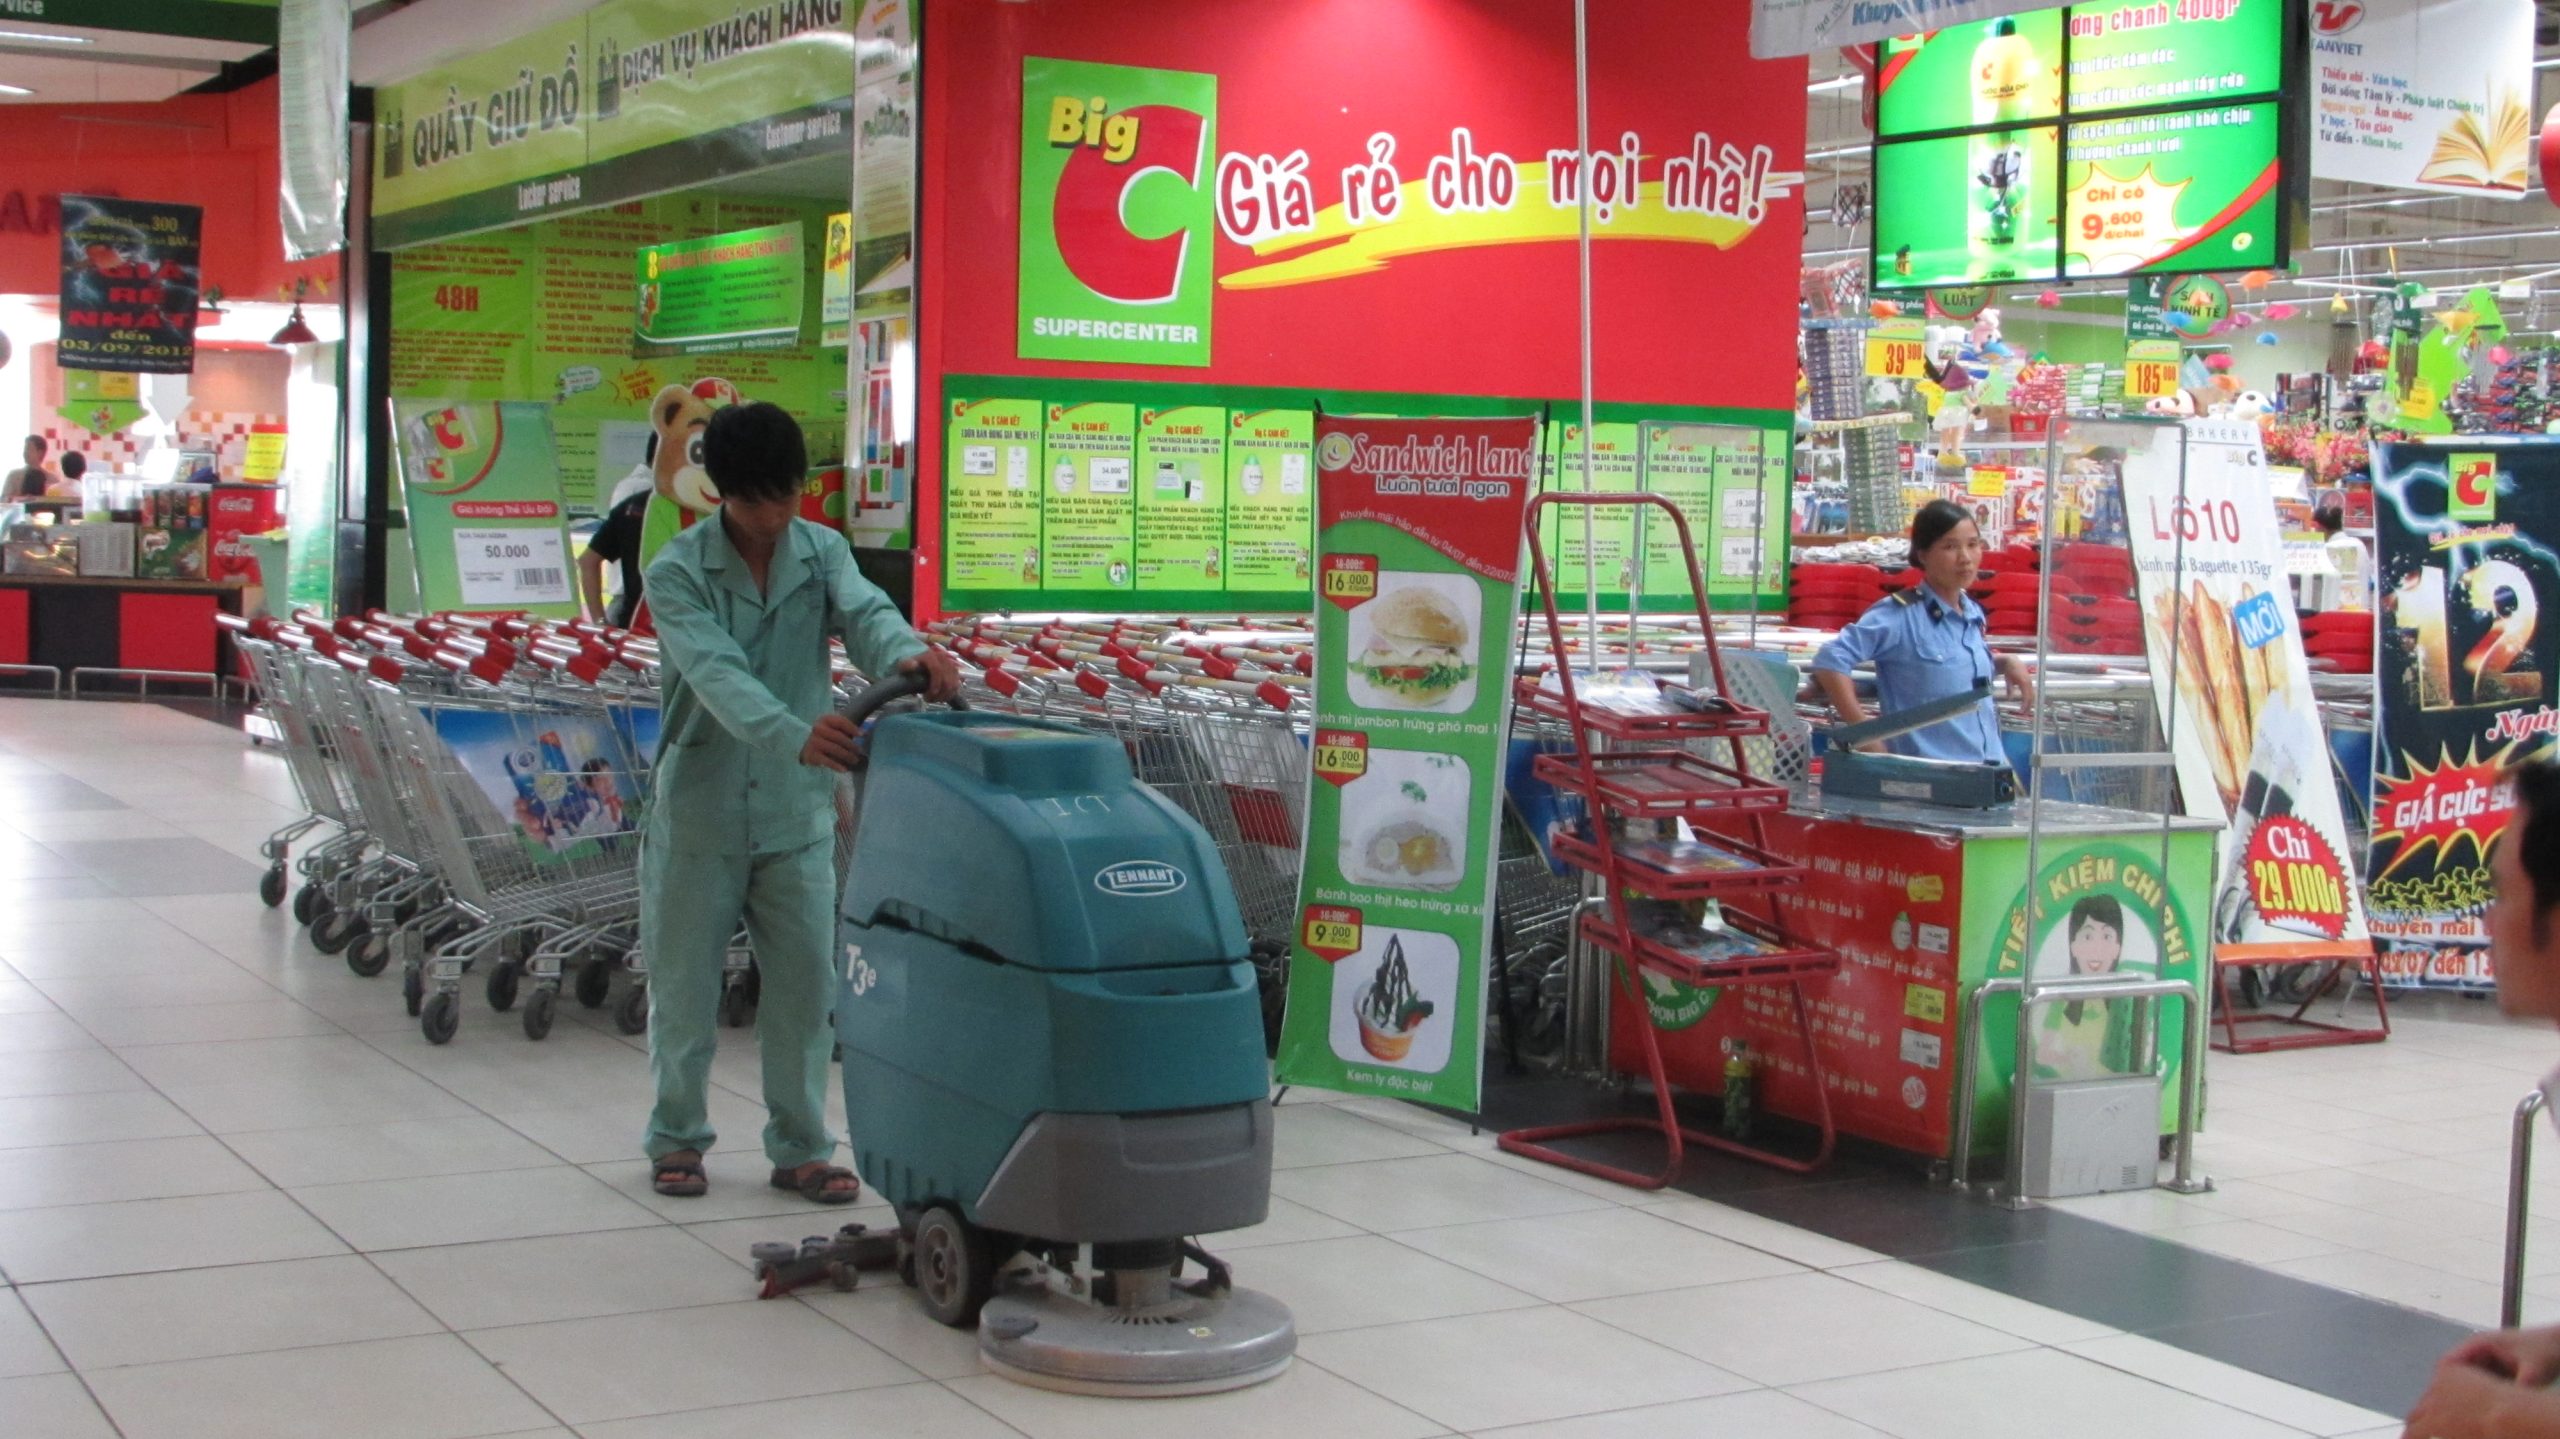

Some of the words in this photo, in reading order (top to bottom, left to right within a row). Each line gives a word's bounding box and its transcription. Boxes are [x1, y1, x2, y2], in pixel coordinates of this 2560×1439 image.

[2110, 3, 2168, 31] chanh
[623, 42, 664, 95] DỊCH
[671, 32, 697, 78] VỤ
[704, 3, 772, 63] KHÁCH
[2322, 67, 2347, 80] Thiếu
[2349, 70, 2363, 81] nhi
[2372, 73, 2389, 85] Văn
[2391, 76, 2408, 88] học
[414, 86, 478, 169] QUẦY
[487, 69, 532, 147] GIỮ
[539, 44, 579, 130] ĐỒ
[2340, 86, 2360, 99] sống
[2364, 88, 2384, 101] Tâm
[2402, 93, 2424, 108] Pháp
[806, 111, 841, 141] service
[2082, 123, 2111, 140] sạch
[2165, 115, 2191, 130] tanh
[2196, 111, 2218, 127] khó
[2223, 107, 2251, 125] chịu
[2329, 115, 2346, 128] học
[2392, 108, 2413, 121] nhạc
[1048, 95, 1140, 166] Big
[2333, 131, 2353, 143] điển
[2116, 141, 2152, 157] chanh
[548, 173, 582, 205] service
[1217, 150, 1314, 246] Giá
[1343, 132, 1400, 224] rẻ
[1427, 127, 1518, 214] cho
[1547, 132, 1640, 224] mọi
[1664, 132, 1773, 224] nhà!
[2086, 185, 2116, 202] Chỉ
[2122, 186, 2144, 200] có
[1053, 104, 1208, 305] C
[435, 284, 480, 312] 48H
[1033, 316, 1198, 343] SUPERCENTER
[1886, 343, 1905, 375] 39
[2136, 363, 2160, 393] 185
[1350, 432, 1472, 475] Sandwich
[1376, 474, 1419, 494] Luôn
[1424, 477, 1458, 493] tươi
[1464, 480, 1509, 499] ngon
[457, 504, 473, 513] Giá
[485, 544, 530, 558] 50.000
[1340, 507, 1375, 520] Khuyến
[1377, 511, 1393, 523] mãi
[1395, 515, 1412, 531] hấp
[1412, 526, 1430, 540] dẫn
[1465, 557, 1482, 571] đến
[2190, 558, 2238, 577] Baguette
[2241, 560, 2272, 580] 135gr
[2240, 606, 2284, 647] MỚI
[2393, 560, 2543, 712] 12
[1339, 714, 1351, 724] mì
[1354, 714, 1400, 728] jambon
[1404, 717, 1434, 732] trứng
[1437, 721, 1461, 732] phô
[1465, 723, 1488, 733] mai
[2394, 783, 2436, 834] GIÁ
[2438, 778, 2486, 827] CỰC
[2267, 826, 2311, 860] Chỉ
[1105, 869, 1175, 889] TENNANT
[1815, 856, 1842, 874] WOW!
[1845, 859, 1861, 879] GIÁ
[1865, 861, 1884, 882] HẤP
[2048, 854, 2116, 903] KIỆM
[2254, 859, 2343, 914] 29.000đ
[1316, 888, 1346, 900] Bánh
[1350, 892, 1371, 903] bao
[1375, 894, 1392, 908] thịt
[1395, 895, 1417, 907] heo
[1421, 898, 1452, 915] trứng
[2434, 946, 2466, 975] đến
[1347, 1069, 1372, 1081] Kem
[1375, 1073, 1385, 1085] ly
[1387, 1075, 1408, 1089] đặc
[1412, 1079, 1433, 1092] biệt
